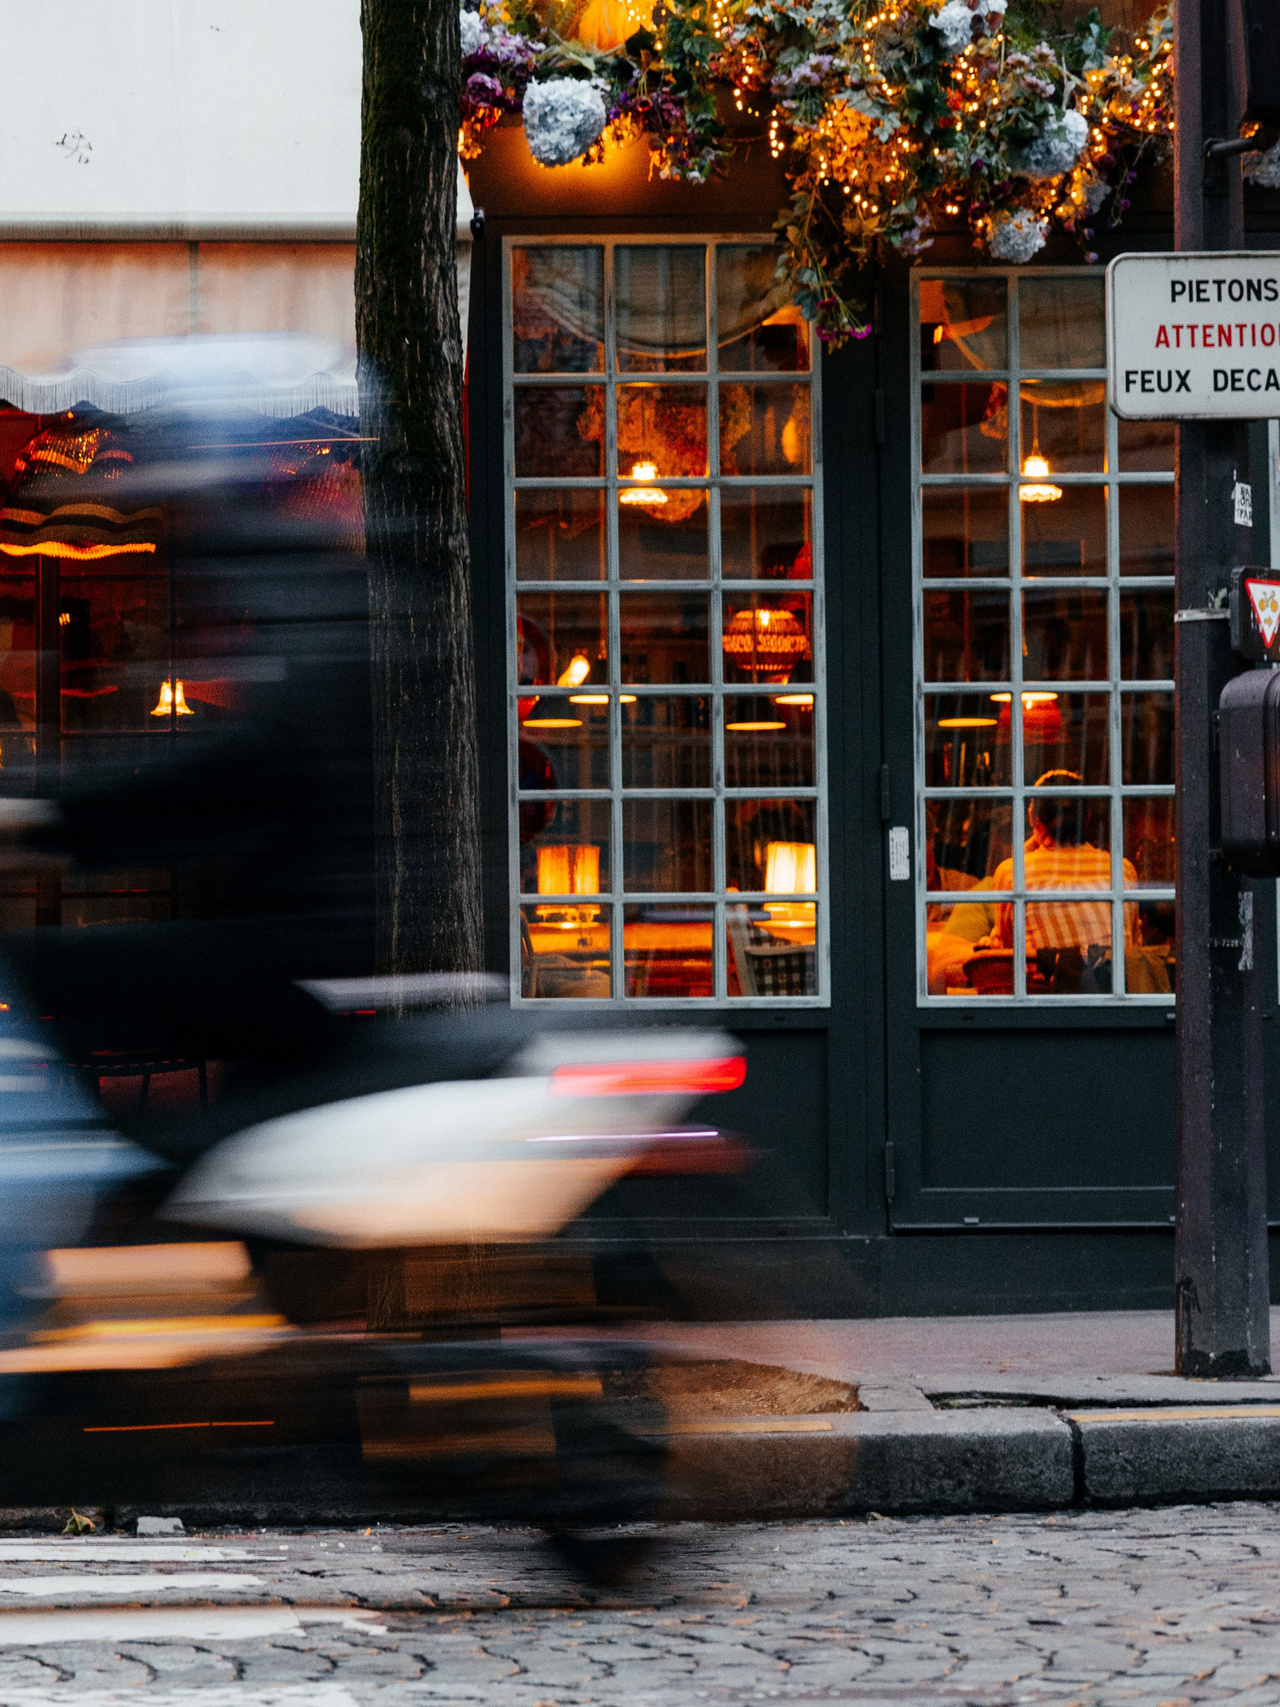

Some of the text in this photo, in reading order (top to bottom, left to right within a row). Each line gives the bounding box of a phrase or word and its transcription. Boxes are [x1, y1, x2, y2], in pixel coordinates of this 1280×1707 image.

[1171, 279, 1279, 303] PIETONS
[1155, 323, 1280, 349] ATTENTIO
[1125, 369, 1192, 394] FEUX
